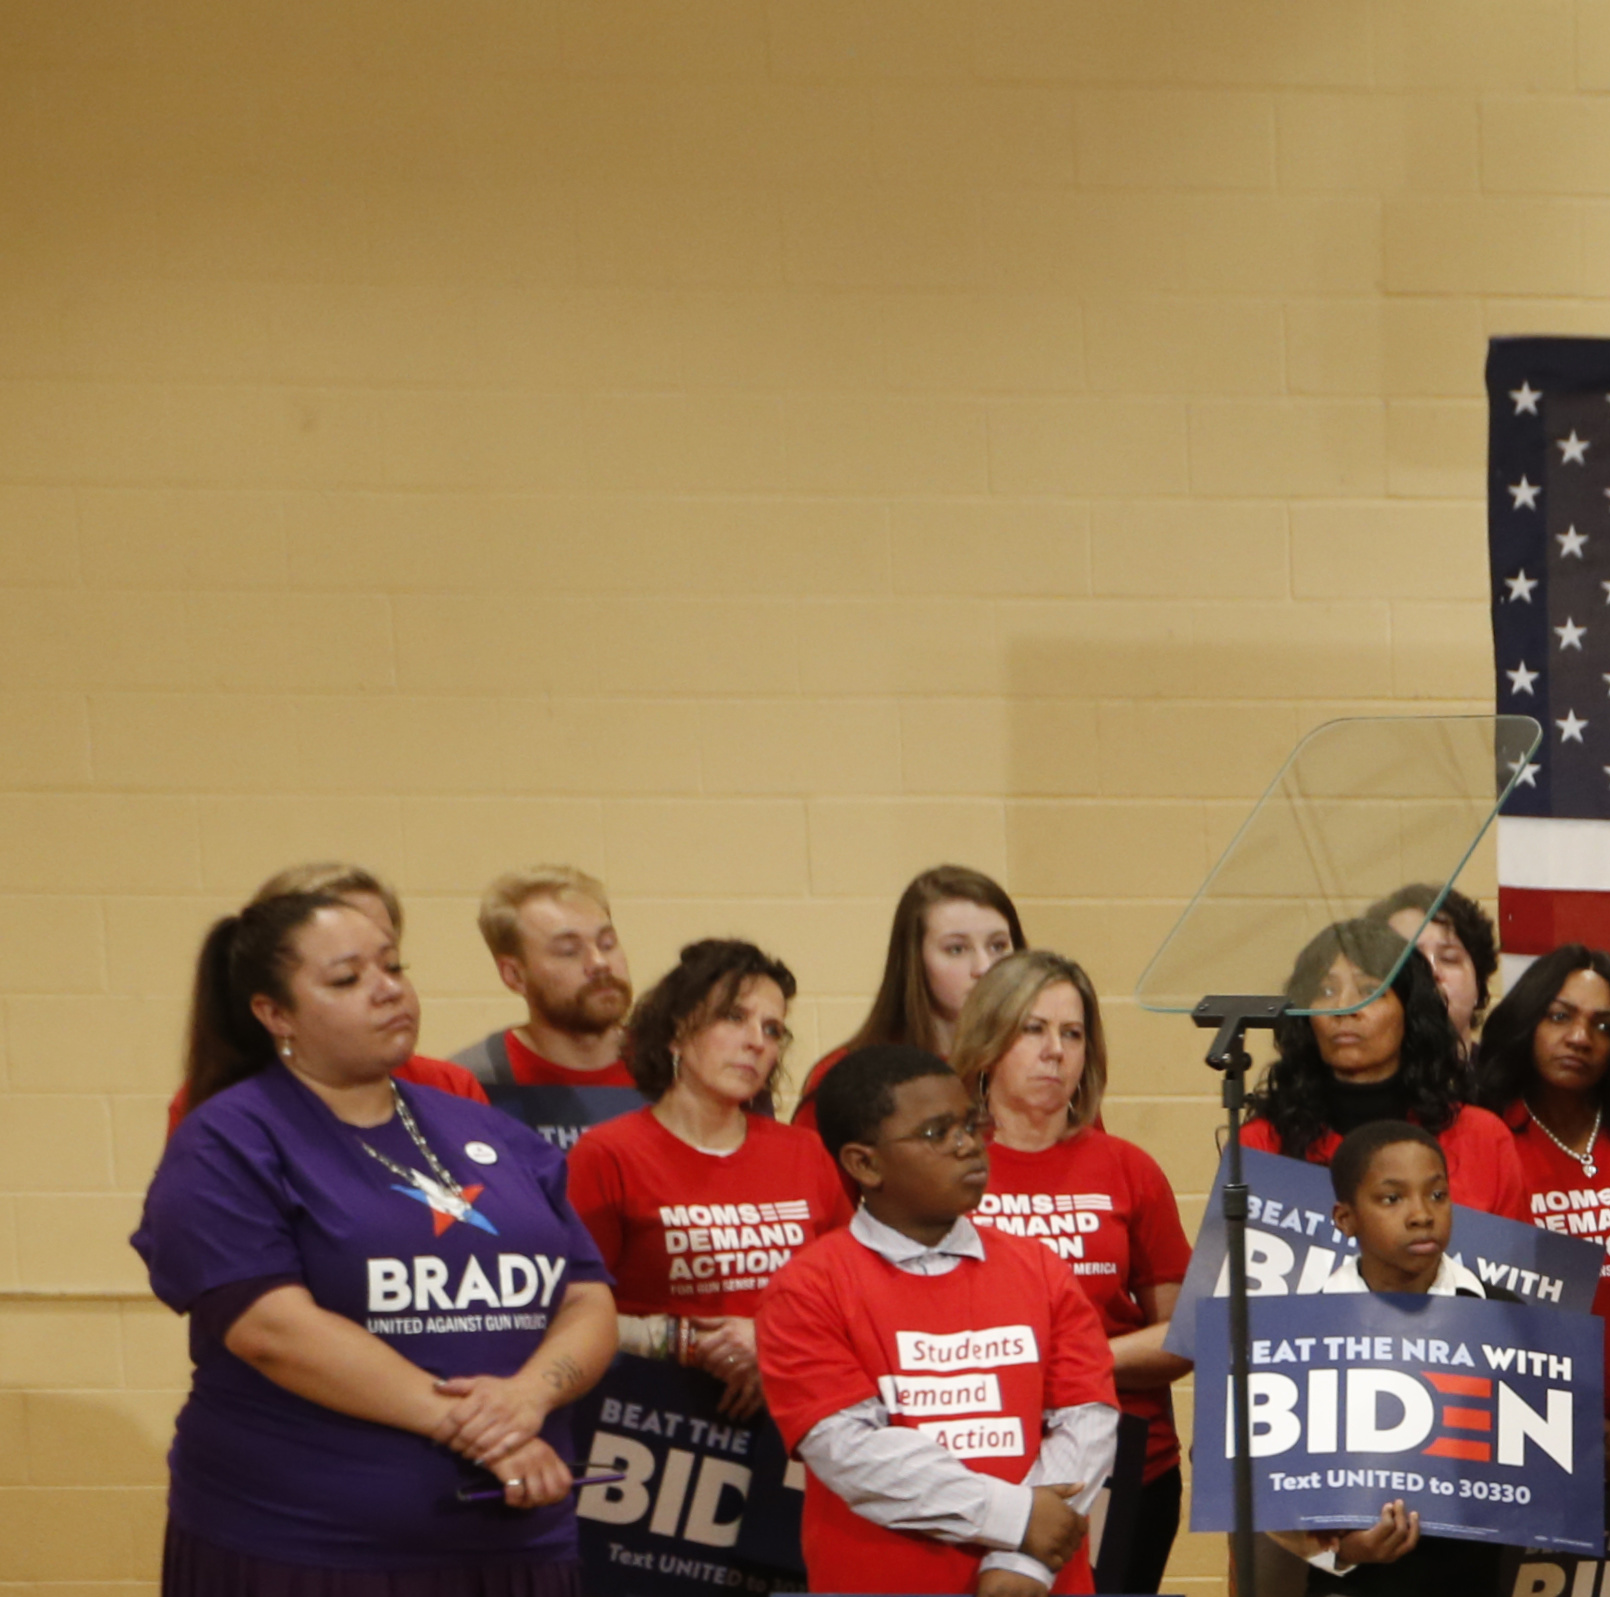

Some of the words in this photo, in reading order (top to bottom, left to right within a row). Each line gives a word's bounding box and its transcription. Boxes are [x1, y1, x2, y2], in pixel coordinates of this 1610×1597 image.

[537, 1126, 590, 1149] TH
[659, 1203, 762, 1227] MOMS
[977, 1193, 1055, 1215] OMS
[664, 1222, 804, 1254] DEMAND
[669, 1249, 791, 1280] ACTION
[1071, 1262, 1117, 1275] MERICA
[367, 1253, 566, 1312] BRADY
[1477, 1258, 1564, 1303] WITH
[367, 1317, 423, 1334] UNITED
[426, 1315, 482, 1333] AGAINST
[485, 1314, 512, 1331] GUN
[912, 1337, 1024, 1364] Students
[1250, 1338, 1316, 1364] EAT
[1324, 1337, 1393, 1361] THE
[1402, 1339, 1475, 1368] NRA
[1482, 1344, 1572, 1382] WITH
[898, 1381, 987, 1407] emand
[600, 1397, 683, 1439] BEAT
[689, 1418, 752, 1455] THE
[1225, 1368, 1573, 1475] BIDEN
[935, 1425, 1016, 1451] Action
[575, 1429, 753, 1548] BID
[1269, 1472, 1322, 1492] Text
[1327, 1469, 1425, 1493] UNITED
[1429, 1476, 1455, 1495] to
[1459, 1479, 1531, 1504] 30330
[608, 1542, 654, 1571] Text
[658, 1555, 742, 1588] UNITED
